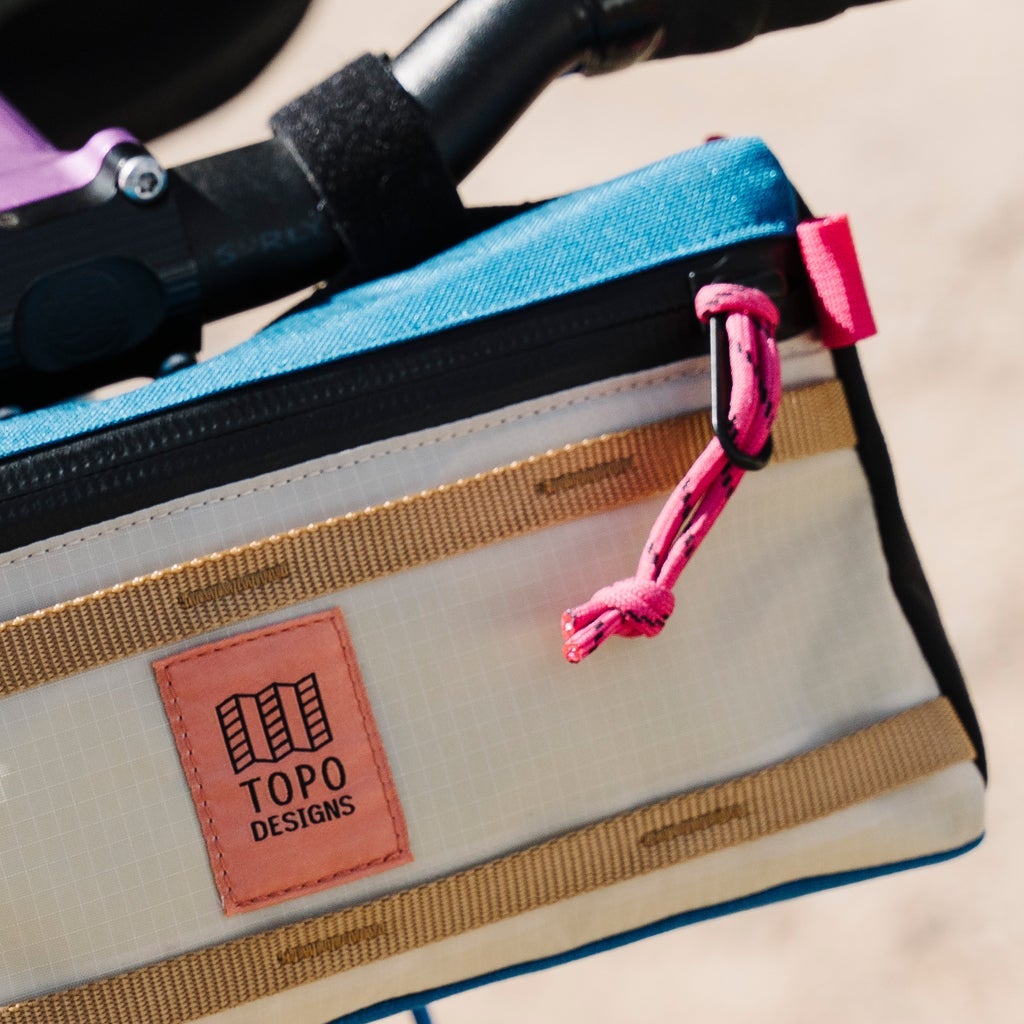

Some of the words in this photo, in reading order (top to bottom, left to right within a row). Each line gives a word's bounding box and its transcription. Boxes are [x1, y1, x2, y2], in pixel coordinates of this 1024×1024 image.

[214, 213, 323, 268] SURLY
[239, 756, 347, 813] TOPO
[250, 795, 356, 842] DESIGNS
